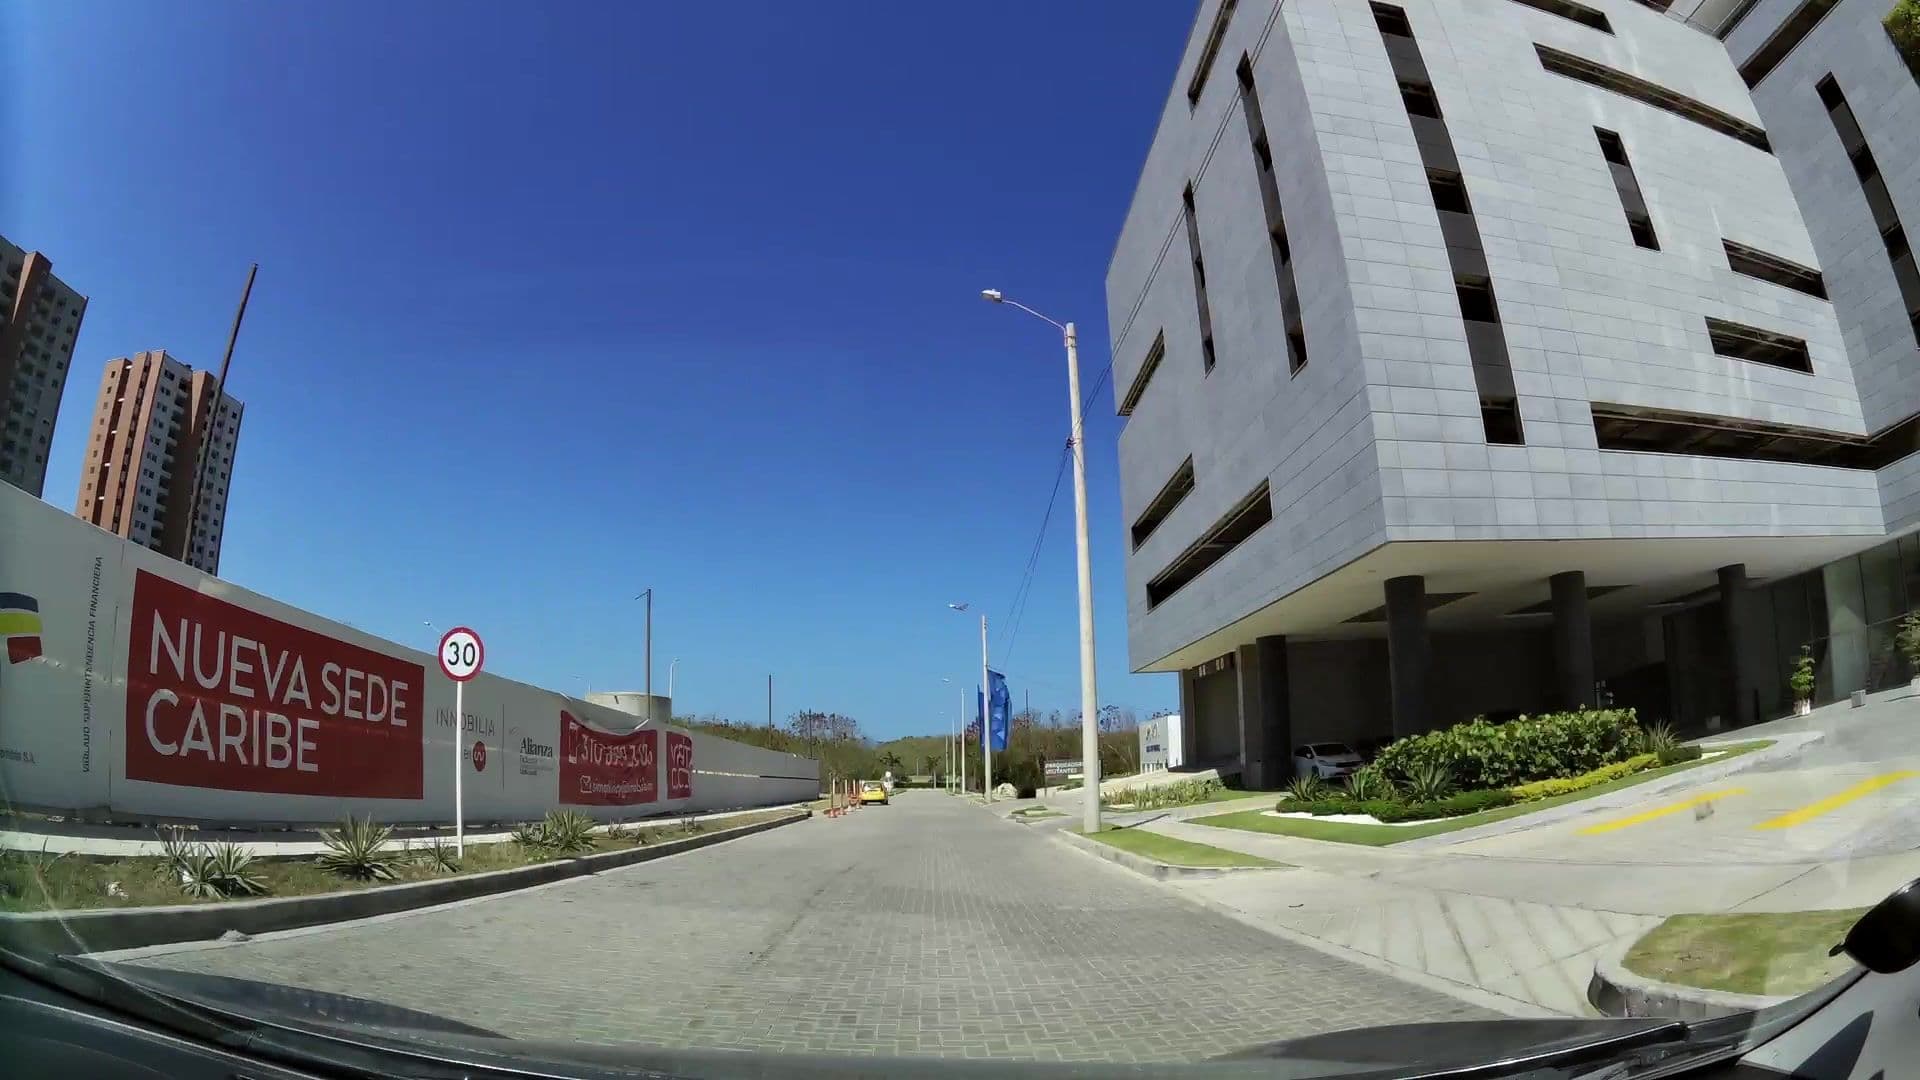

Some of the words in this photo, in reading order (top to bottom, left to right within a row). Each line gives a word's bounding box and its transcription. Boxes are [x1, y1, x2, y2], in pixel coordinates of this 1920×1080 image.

[89, 557, 104, 618] FINANCIERA
[84, 619, 96, 724] SUPERINTENDENCIA
[150, 608, 312, 710] NUEVA
[320, 661, 409, 727] SEDE
[447, 641, 476, 667] 30
[145, 688, 320, 772] CARIBE
[520, 737, 554, 758] Alianza
